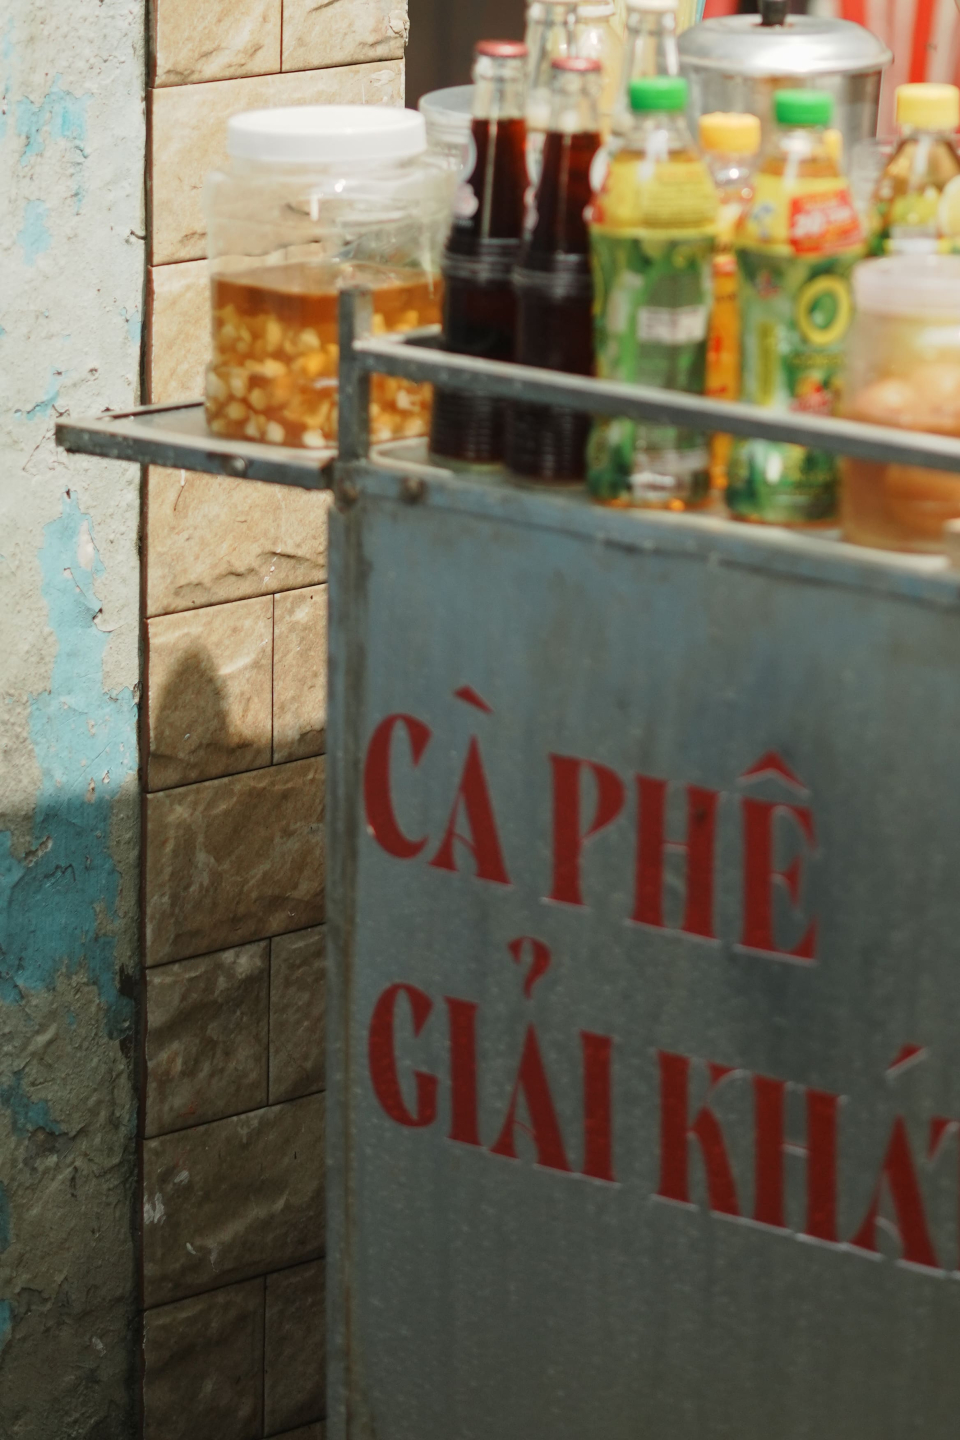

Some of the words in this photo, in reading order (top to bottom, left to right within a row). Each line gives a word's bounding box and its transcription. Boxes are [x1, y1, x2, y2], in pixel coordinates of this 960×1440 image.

[362, 685, 515, 888] CÀ
[539, 750, 821, 967] PHÊ
[367, 935, 621, 1188] GIẢI
